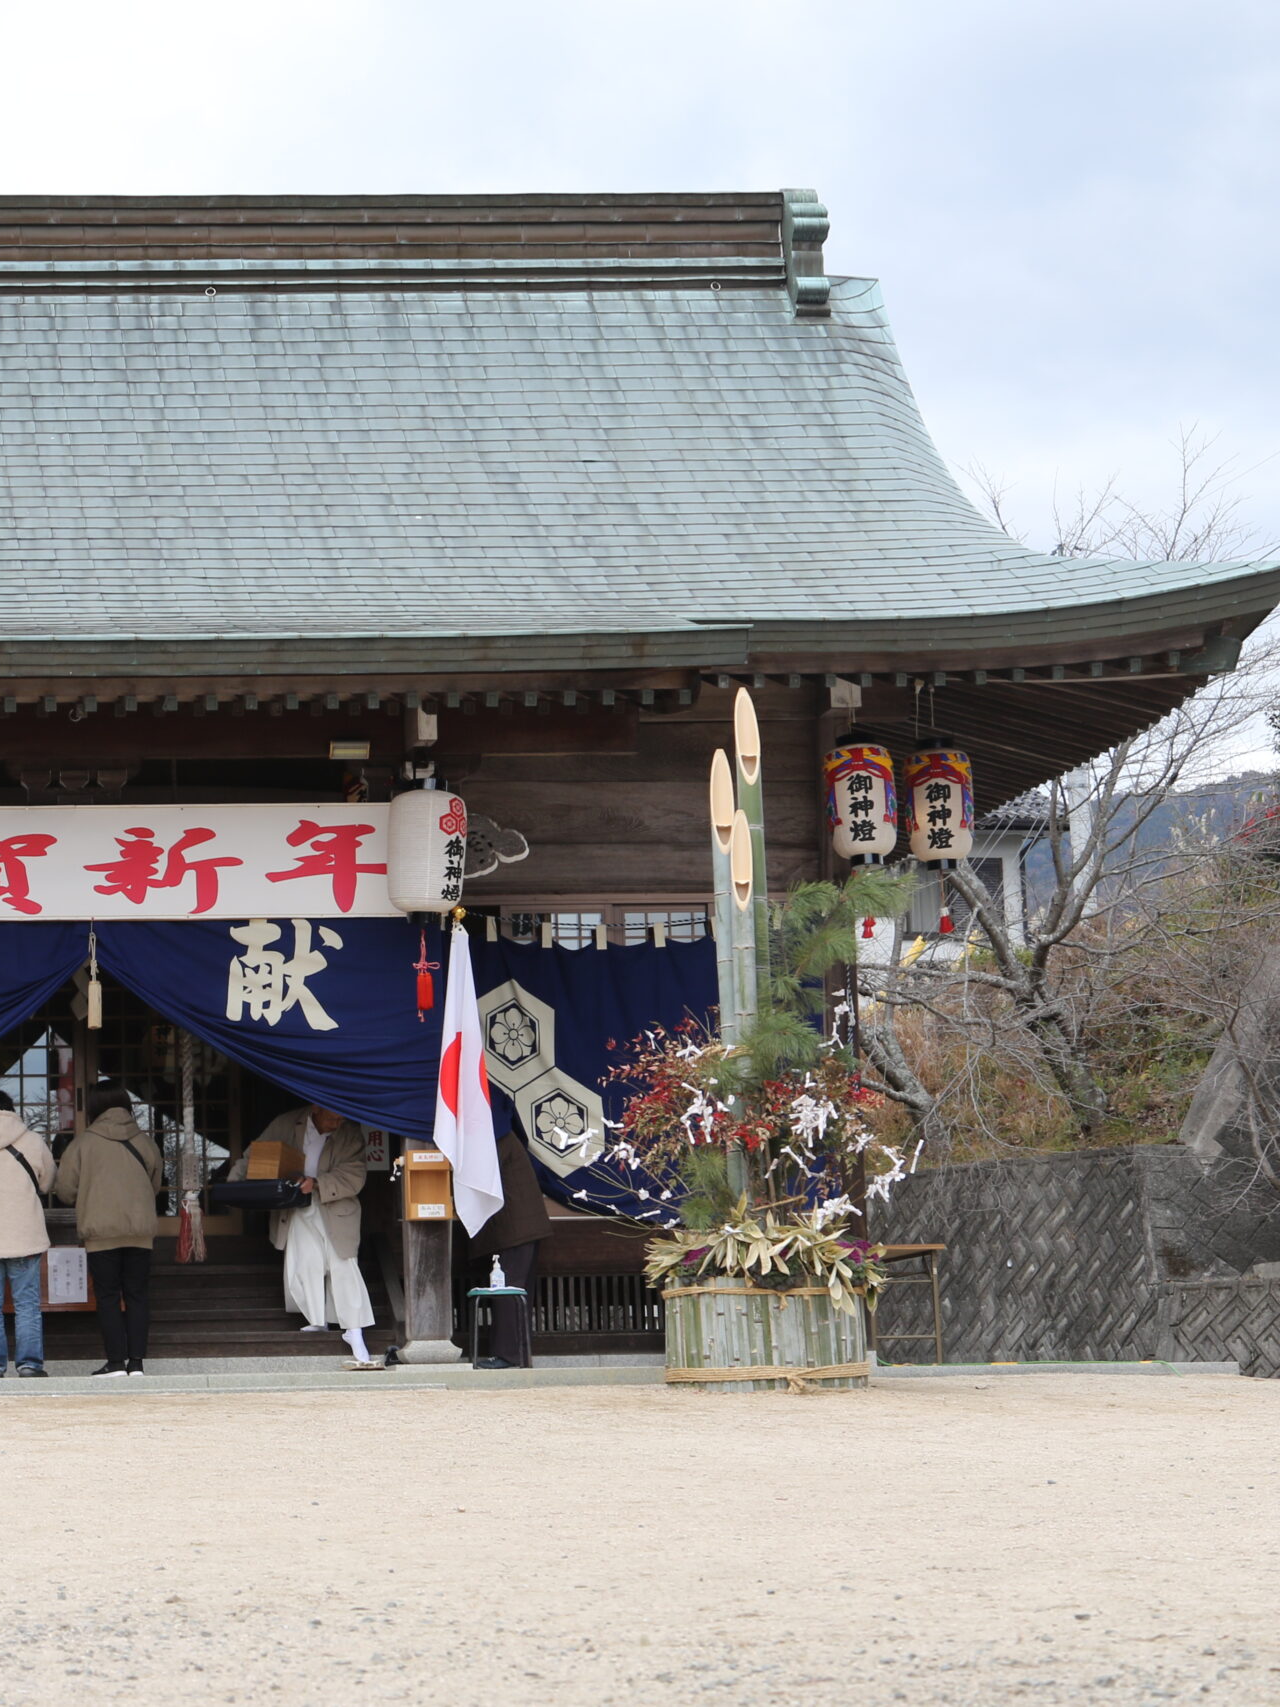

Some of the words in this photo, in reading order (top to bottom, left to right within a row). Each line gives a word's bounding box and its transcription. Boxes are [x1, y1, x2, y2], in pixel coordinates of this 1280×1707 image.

[848, 774, 877, 842] 御神燈
[925, 783, 955, 849] 御神燈
